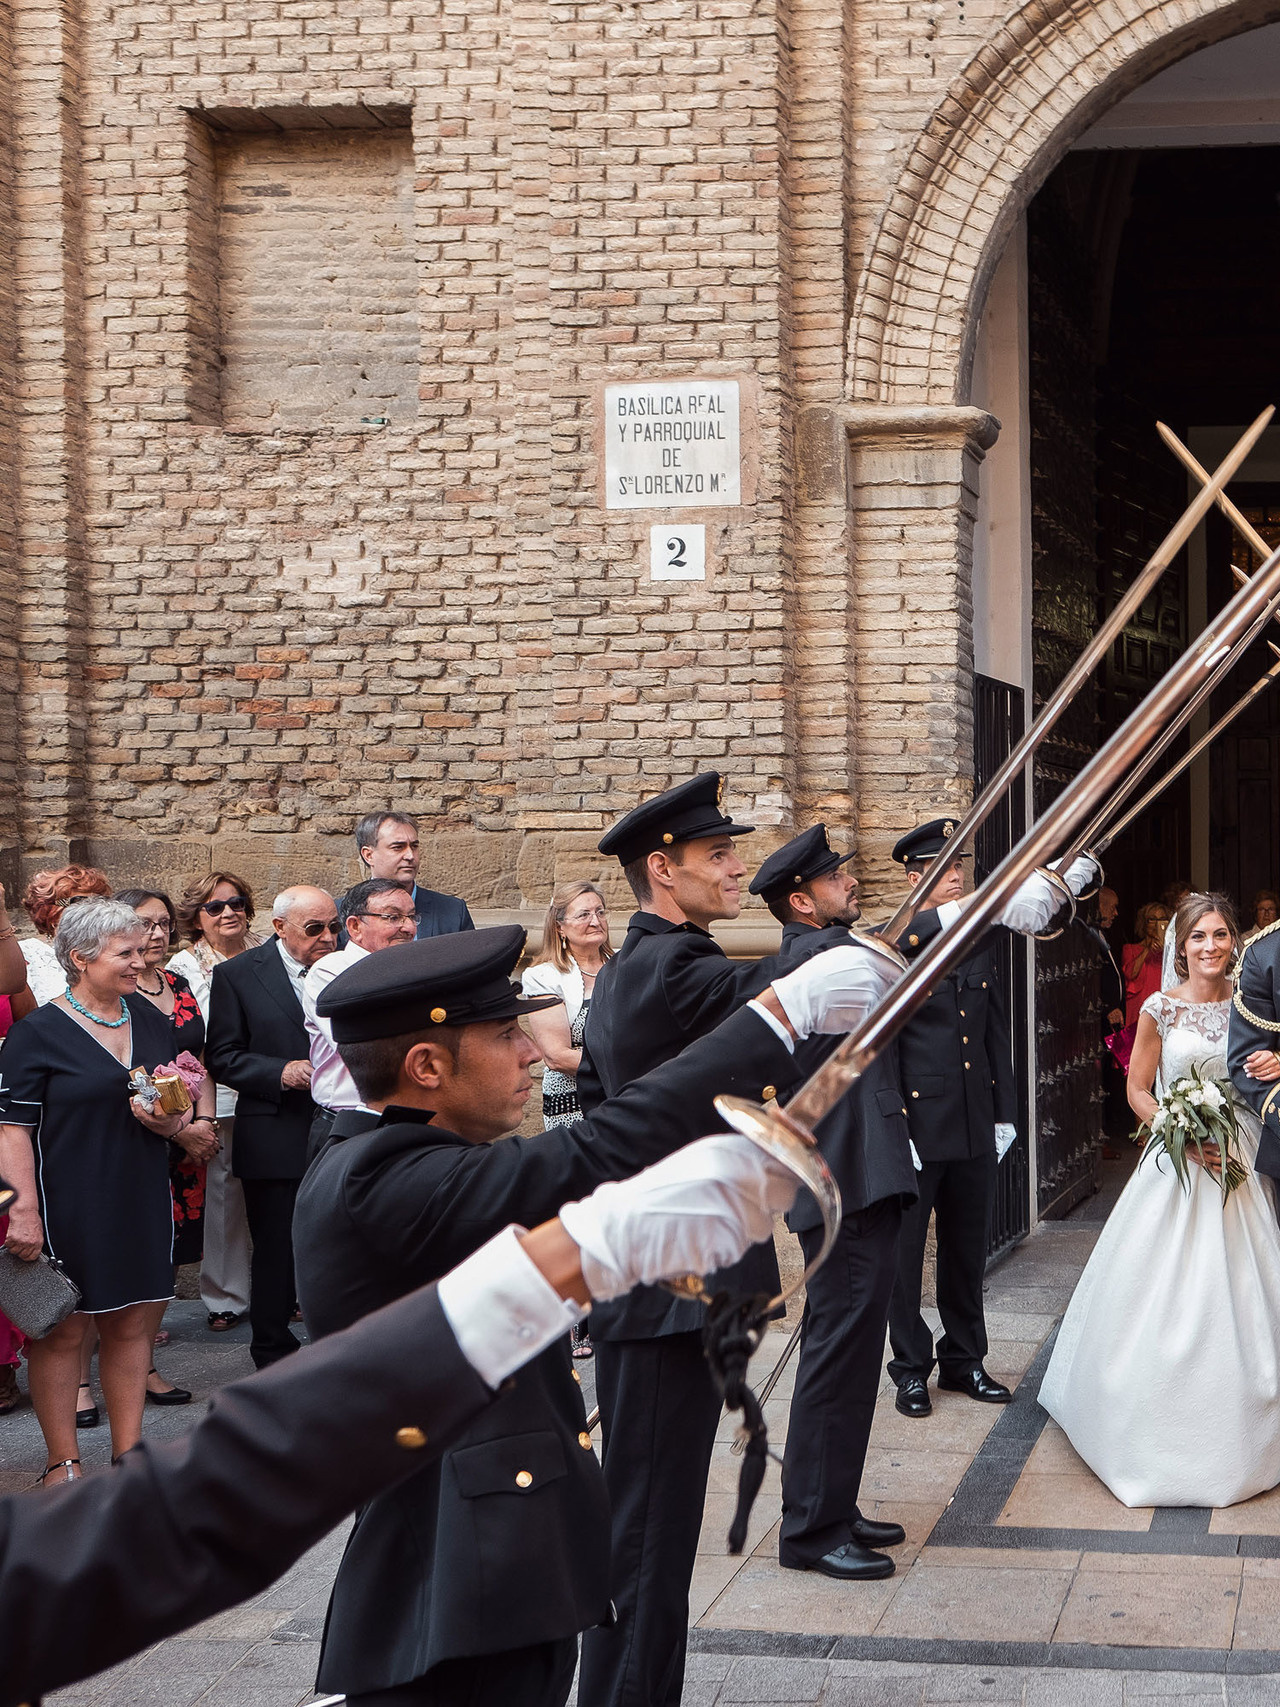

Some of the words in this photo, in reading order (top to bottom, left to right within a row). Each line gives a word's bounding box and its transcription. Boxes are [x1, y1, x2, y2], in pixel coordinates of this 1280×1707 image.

[689, 394, 726, 416] REAL
[618, 423, 628, 443] Y
[633, 421, 726, 443] PARROQUIAL
[662, 448, 682, 468] DE
[666, 537, 688, 568] 2
